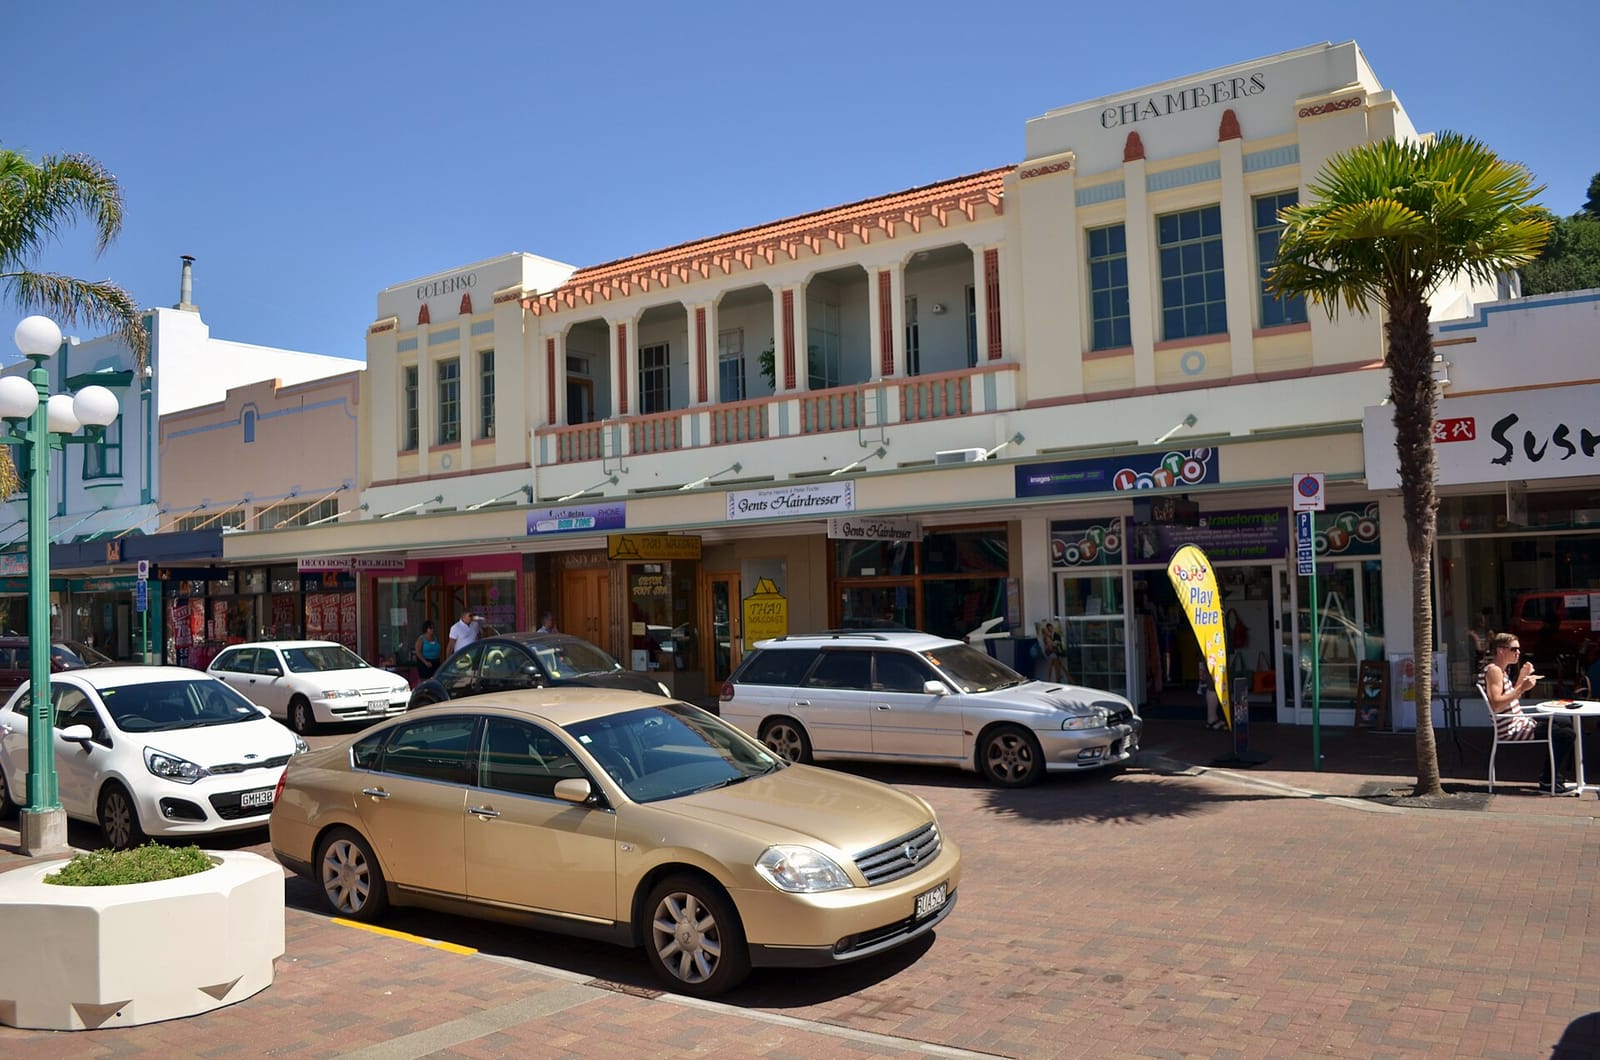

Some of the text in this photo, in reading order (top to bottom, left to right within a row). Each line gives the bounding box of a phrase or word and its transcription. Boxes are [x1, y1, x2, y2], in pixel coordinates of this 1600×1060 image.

[1100, 72, 1266, 129] CHAMBERS
[416, 272, 477, 300] COLENSO
[1119, 454, 1200, 490] LOTTO
[738, 493, 841, 513] Gents Hairdresser
[1208, 511, 1280, 526] transformed
[866, 523, 912, 538] Hairdresser
[1052, 529, 1119, 562] LOTTO
[327, 559, 351, 567] ROSE
[1190, 587, 1213, 607] Play
[1194, 608, 1218, 624] Here
